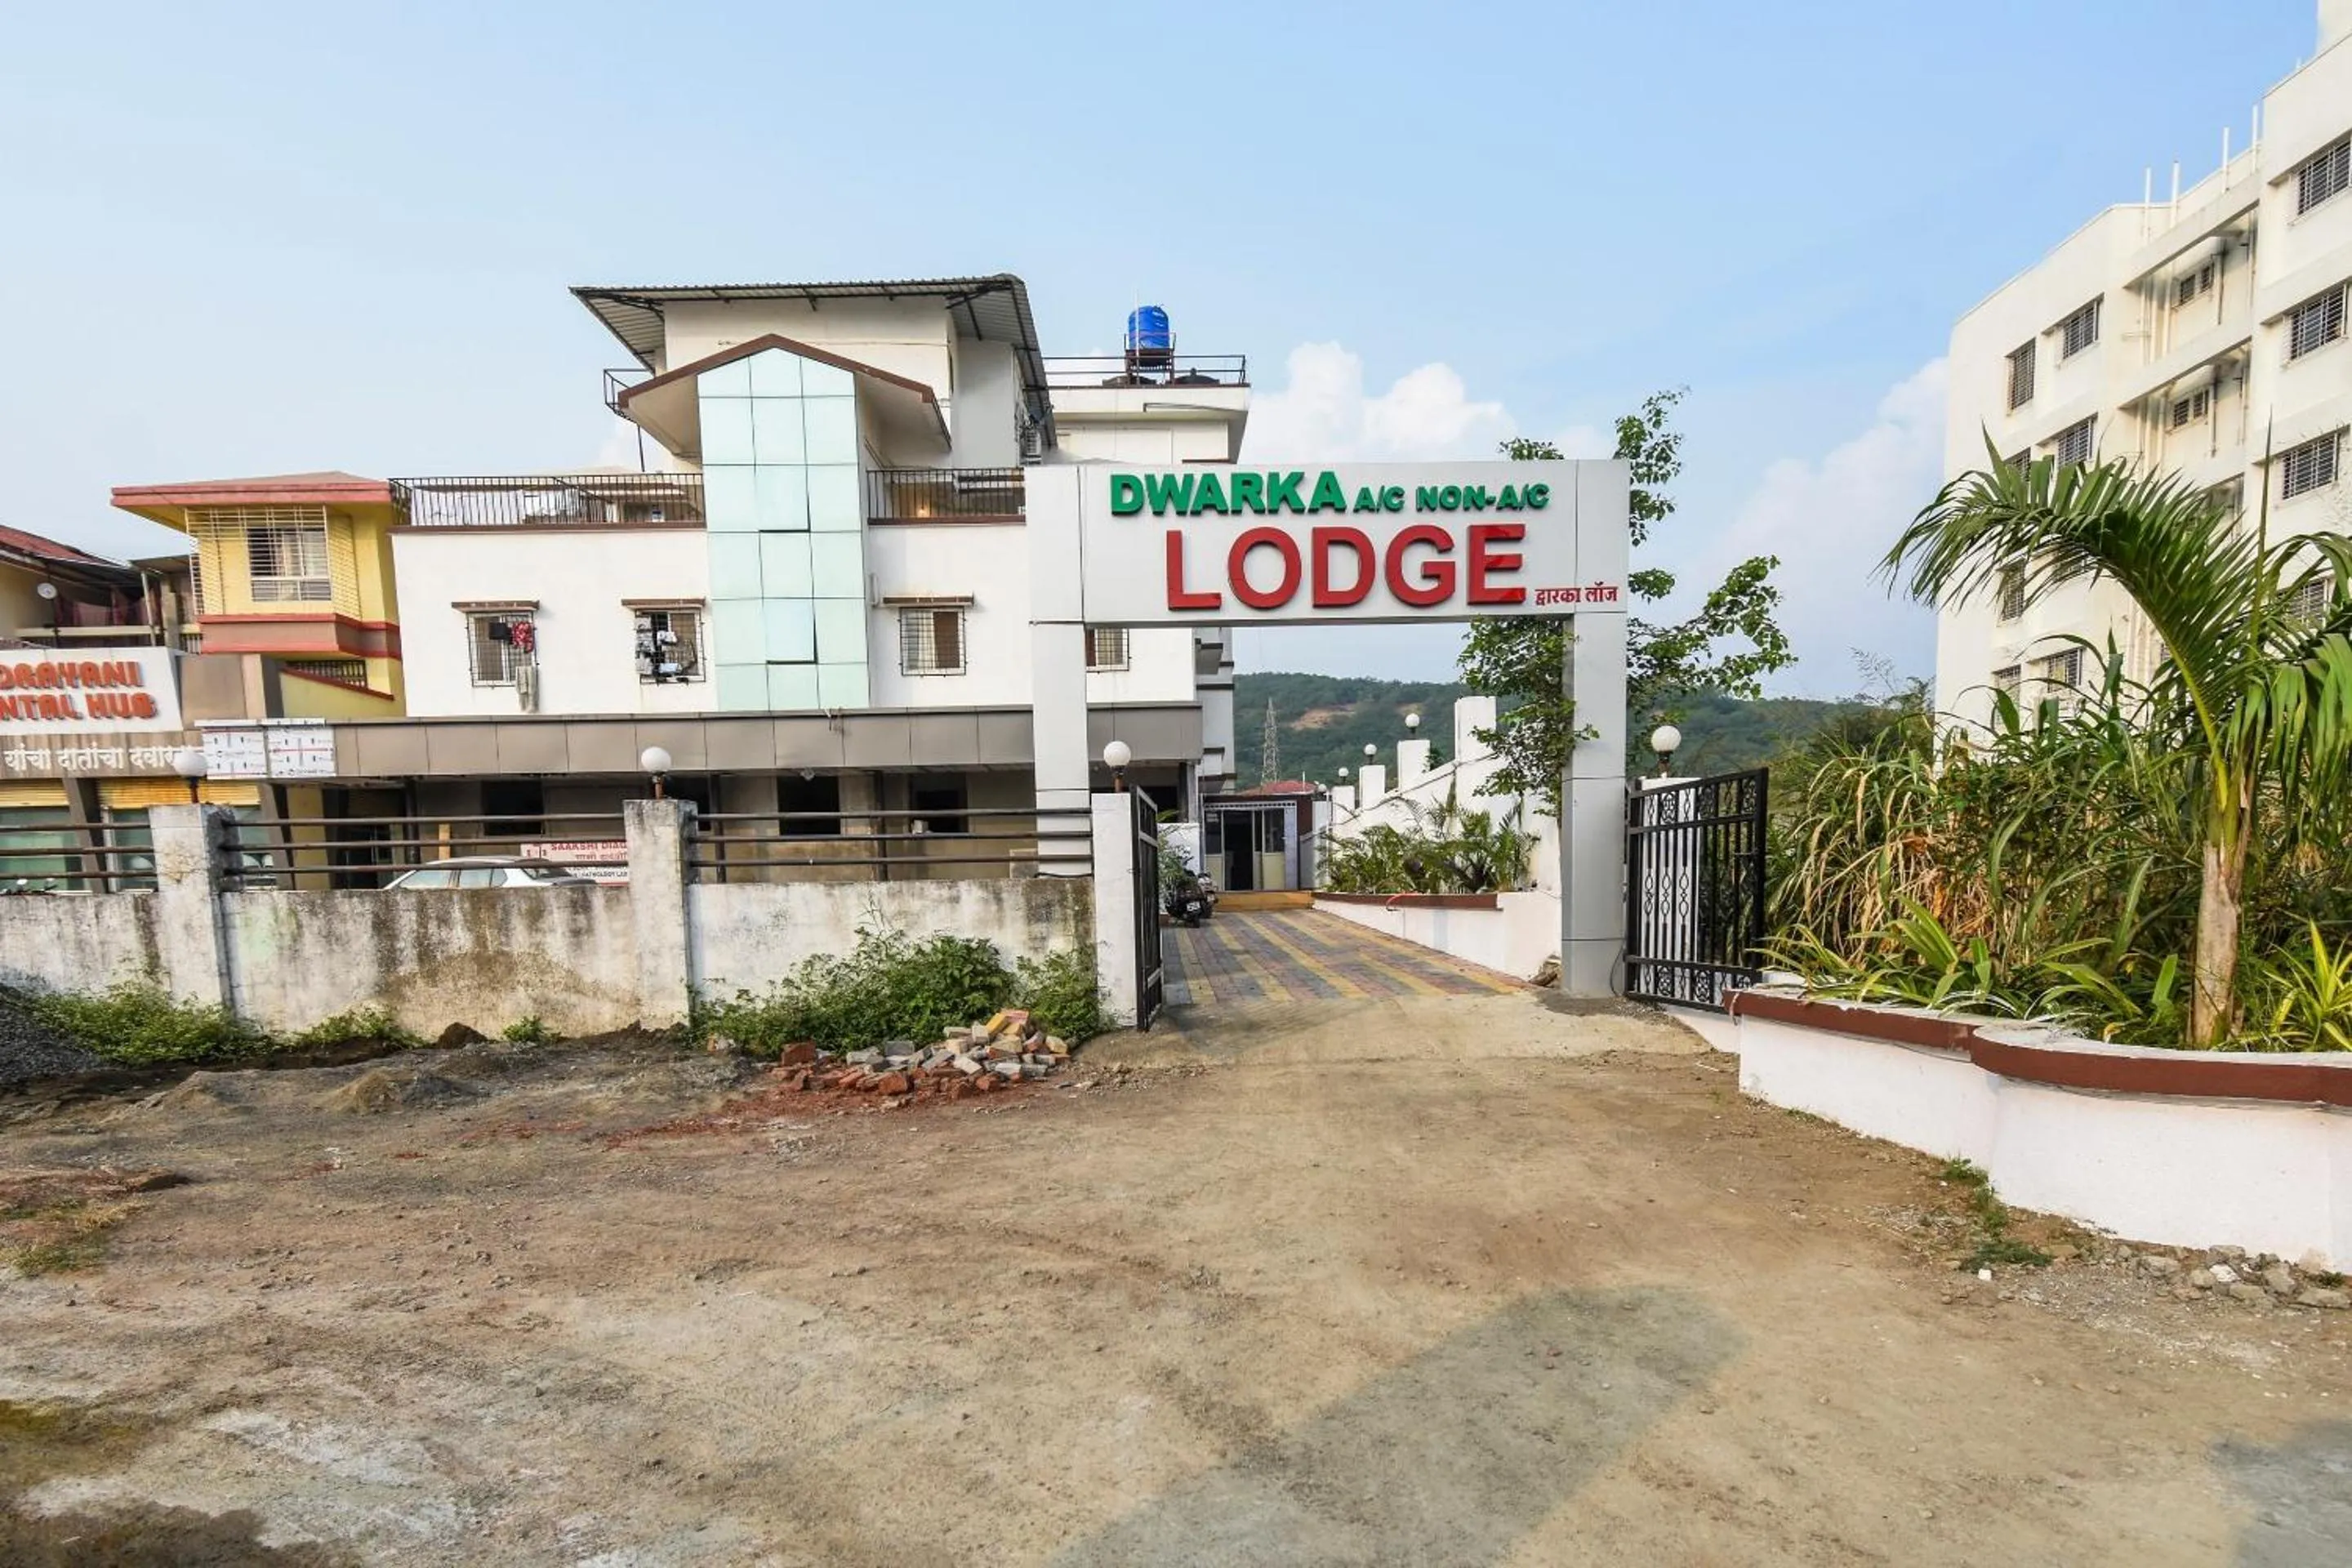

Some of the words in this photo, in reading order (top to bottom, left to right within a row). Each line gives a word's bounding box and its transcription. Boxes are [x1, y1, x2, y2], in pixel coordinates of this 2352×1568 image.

[1110, 470, 1347, 516] DWARKA
[1353, 484, 1406, 514] A/C
[1415, 483, 1550, 513] NON-A/C
[1166, 523, 1526, 612] LODGE
[1535, 586, 1582, 606] द्वारका
[1585, 581, 1619, 603] लॉज
[85, 693, 158, 719] HUB
